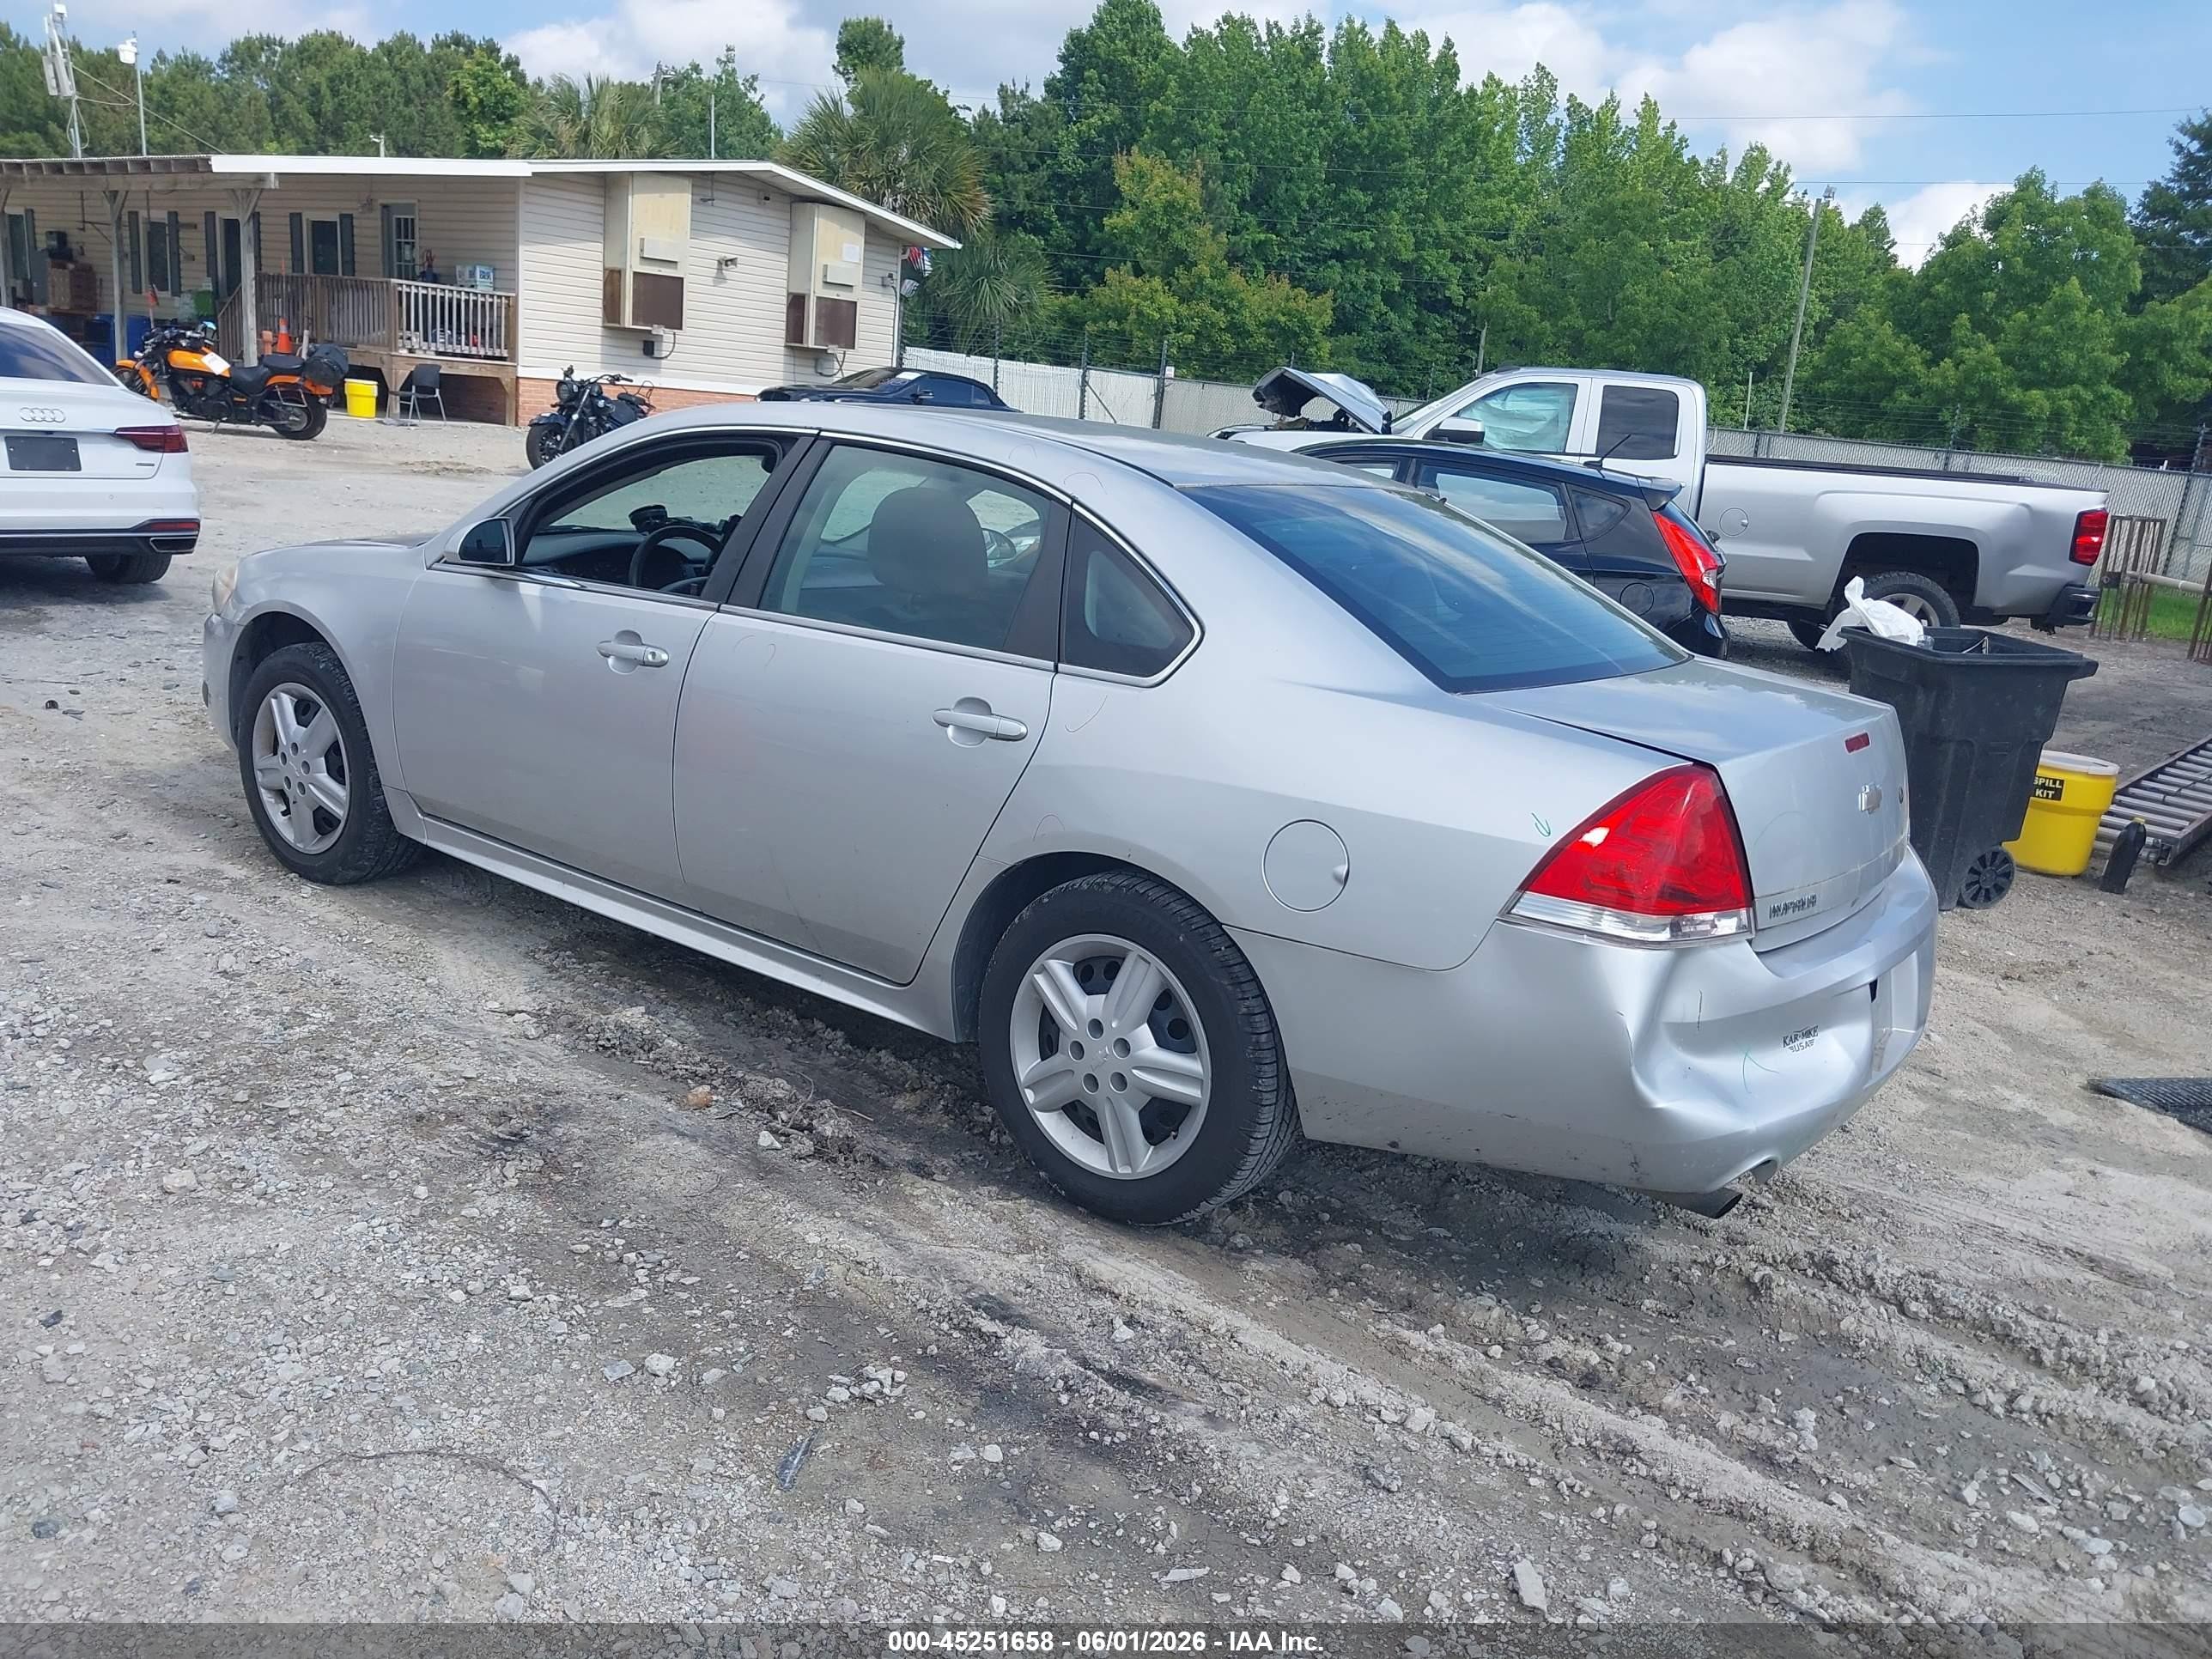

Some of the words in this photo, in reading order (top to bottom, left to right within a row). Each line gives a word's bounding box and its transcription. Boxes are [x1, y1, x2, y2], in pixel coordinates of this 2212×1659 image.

[2033, 776, 2063, 788] SPILL
[2035, 788, 2055, 799] KIT
[1794, 1040, 1808, 1052] USA
